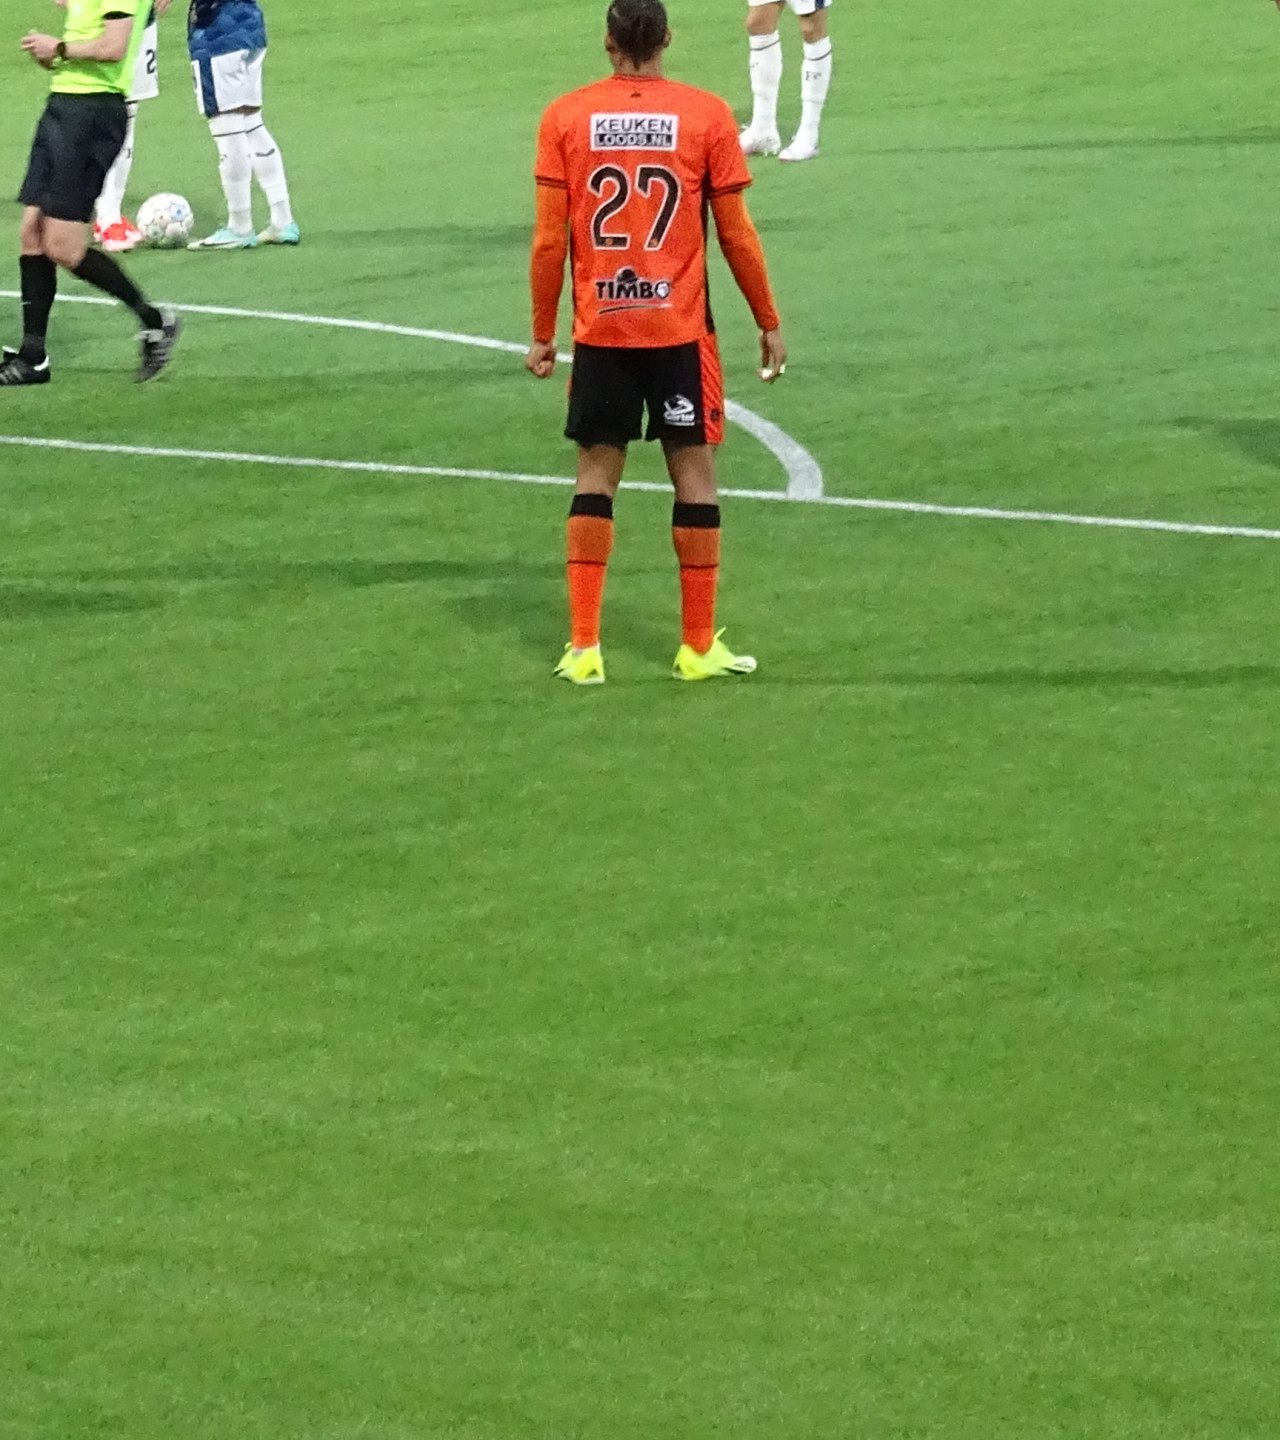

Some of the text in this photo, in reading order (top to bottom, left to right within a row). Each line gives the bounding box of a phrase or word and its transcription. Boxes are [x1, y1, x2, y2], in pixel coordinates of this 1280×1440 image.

[596, 118, 673, 133] KEUKEN
[596, 133, 672, 147] LOODS.NL
[588, 164, 682, 250] 27
[595, 280, 672, 301] TIMBO
